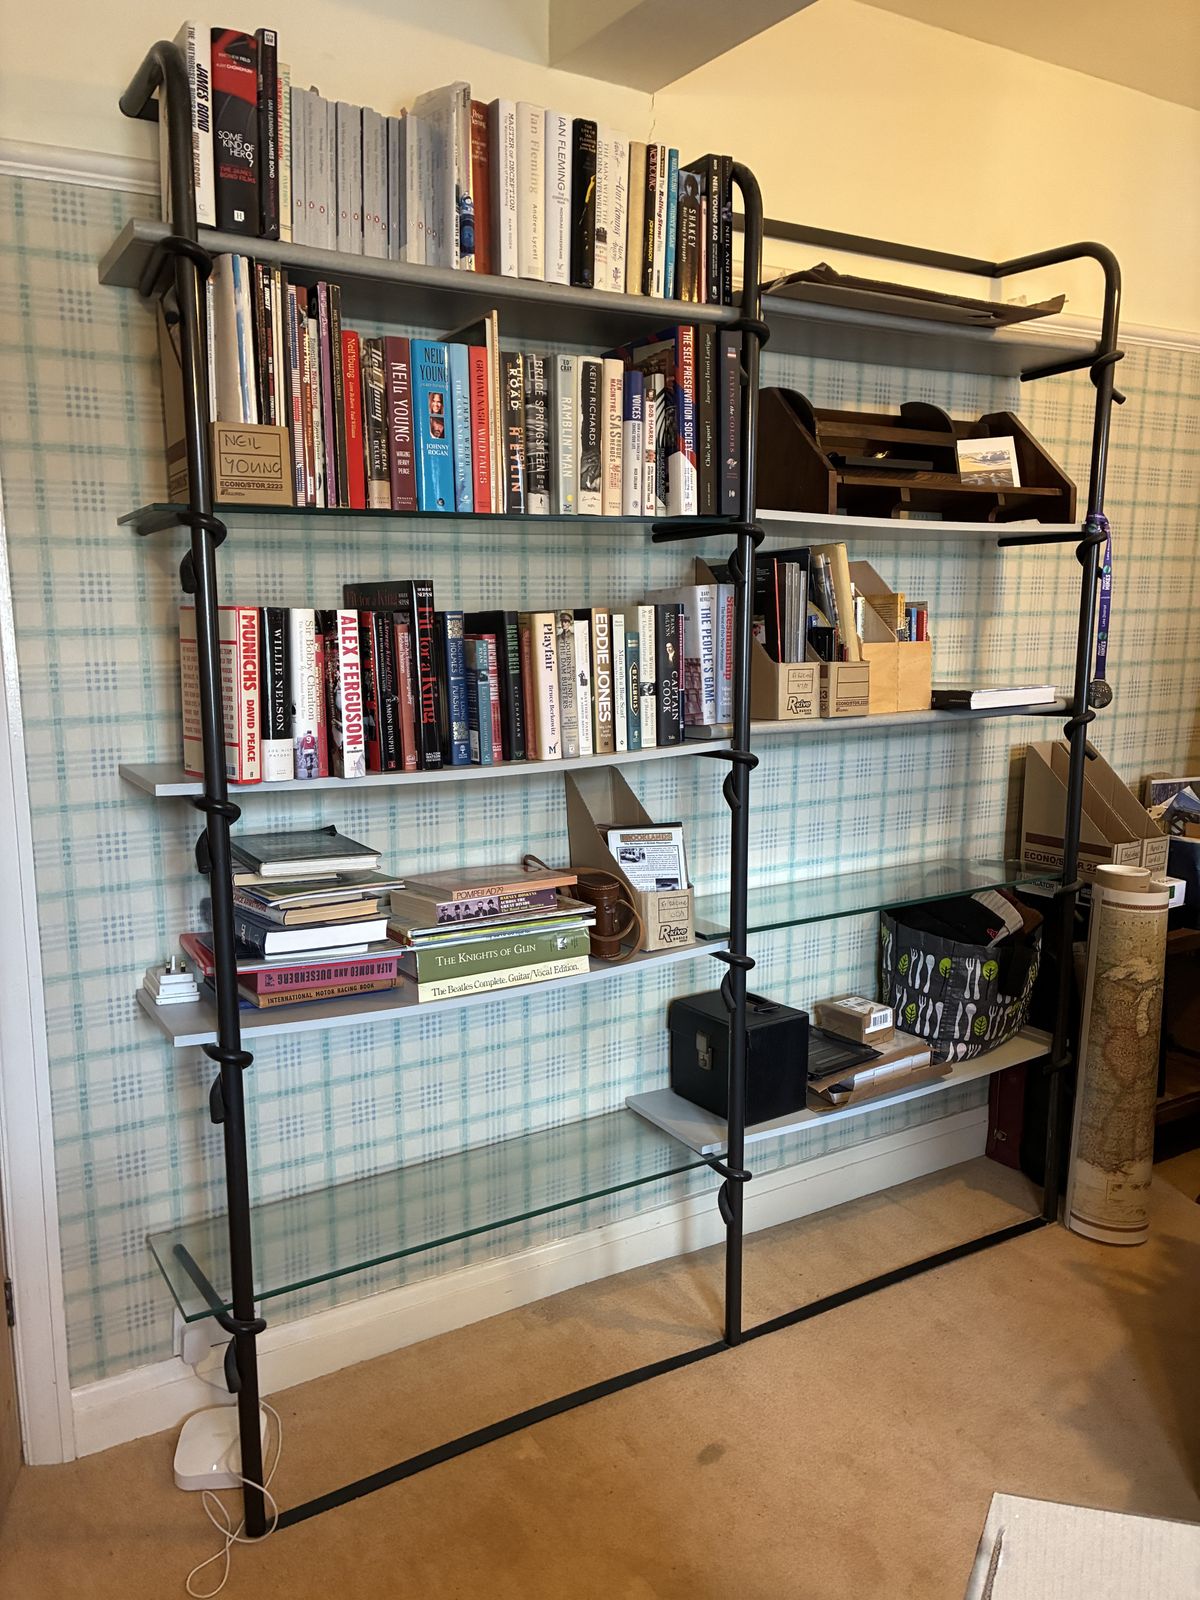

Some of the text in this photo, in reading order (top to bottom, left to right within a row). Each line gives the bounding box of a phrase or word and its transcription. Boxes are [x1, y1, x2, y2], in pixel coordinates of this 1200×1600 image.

[196, 64, 209, 133] JAMES BOND
[218, 130, 242, 142] SOME
[222, 140, 254, 152] KIND OF
[558, 117, 566, 136] IAN
[230, 148, 252, 160] HERO
[528, 113, 540, 194] Ian Fleming
[557, 140, 566, 191] FLEMING
[688, 208, 696, 247] SHAKEY
[724, 276, 730, 291] ME
[346, 338, 356, 378] Neil Young
[420, 366, 448, 382] YOUNG
[424, 348, 444, 364] NEIL
[369, 348, 384, 422] Neil Young
[390, 362, 410, 442] NEIL YOUNG
[682, 331, 693, 452] THE SELF PRESERVATION SOCIETY
[475, 360, 488, 484] GRAHAM NASH WILD TALES
[534, 361, 545, 472] BRUCE SPRINGSTEEN
[632, 394, 642, 418] VOICES
[225, 434, 262, 450] NEIL
[561, 397, 573, 478] RAMBLIN' MAN
[610, 414, 622, 439] SAS
[224, 456, 281, 474] YOUNG
[508, 427, 521, 492] HEYLIN
[340, 616, 358, 656] ALEX
[506, 624, 520, 674] RACING GREEN
[542, 624, 554, 672] Playfair
[700, 607, 715, 704] THE PEOPLE'S GAME
[724, 596, 734, 680] Statesmanship
[274, 629, 284, 730] WILLIE NELSON
[305, 620, 316, 720] Sir Bobby Charlton
[418, 607, 437, 724] Fit for a King
[488, 644, 498, 700] WICHITA LINEMAN
[596, 614, 611, 722] EDDIE JONES
[632, 670, 638, 680] EX
[242, 615, 256, 762] MUNICHS DAVID PEACE
[343, 662, 363, 746] FERGUSON
[662, 680, 671, 712] COOK
[671, 670, 679, 720] CAPTAIN
[385, 698, 394, 724] EAMON
[1024, 852, 1084, 870] ECONO/SR
[456, 888, 484, 899] POMPEII
[277, 962, 392, 985] ALFA ROMEO AND DUESENBERG
[434, 944, 536, 966] THE KNIGHTS OF GLIN
[267, 992, 312, 1004] INTERNATIONAL
[316, 988, 335, 996] MOTOR
[338, 985, 357, 993] RACING
[432, 963, 580, 996] The Beatles Complete. Guitar/Vocal Edition.
